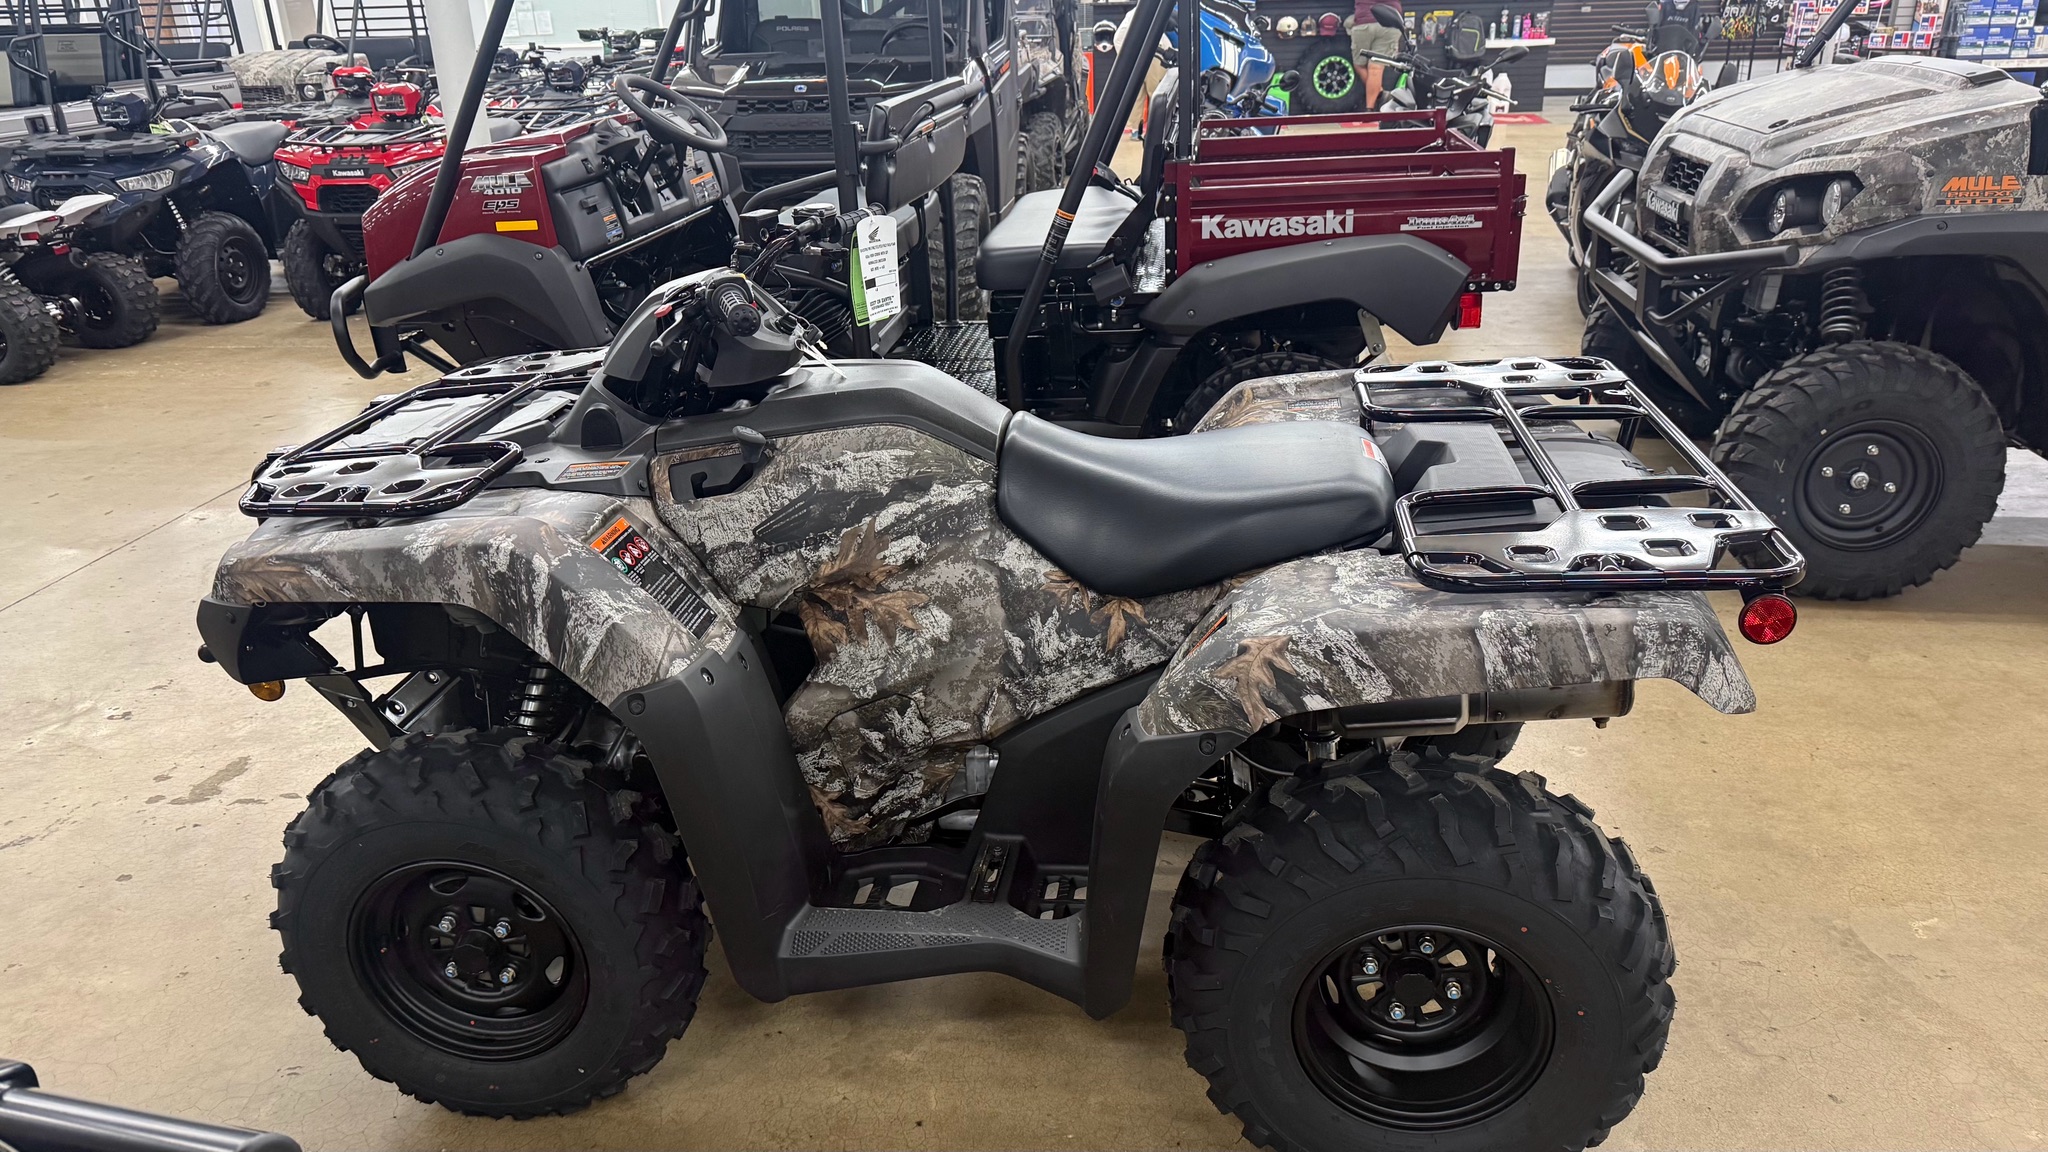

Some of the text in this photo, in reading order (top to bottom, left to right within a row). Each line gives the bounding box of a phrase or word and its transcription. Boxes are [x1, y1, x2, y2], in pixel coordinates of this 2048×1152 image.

[212, 82, 235, 91] Kawasaki
[470, 173, 534, 190] MULE
[1941, 175, 2021, 191] MULE
[483, 187, 522, 195] 4010
[1646, 189, 1680, 222] Kawasaki
[1201, 208, 1354, 240] Kawasaki
